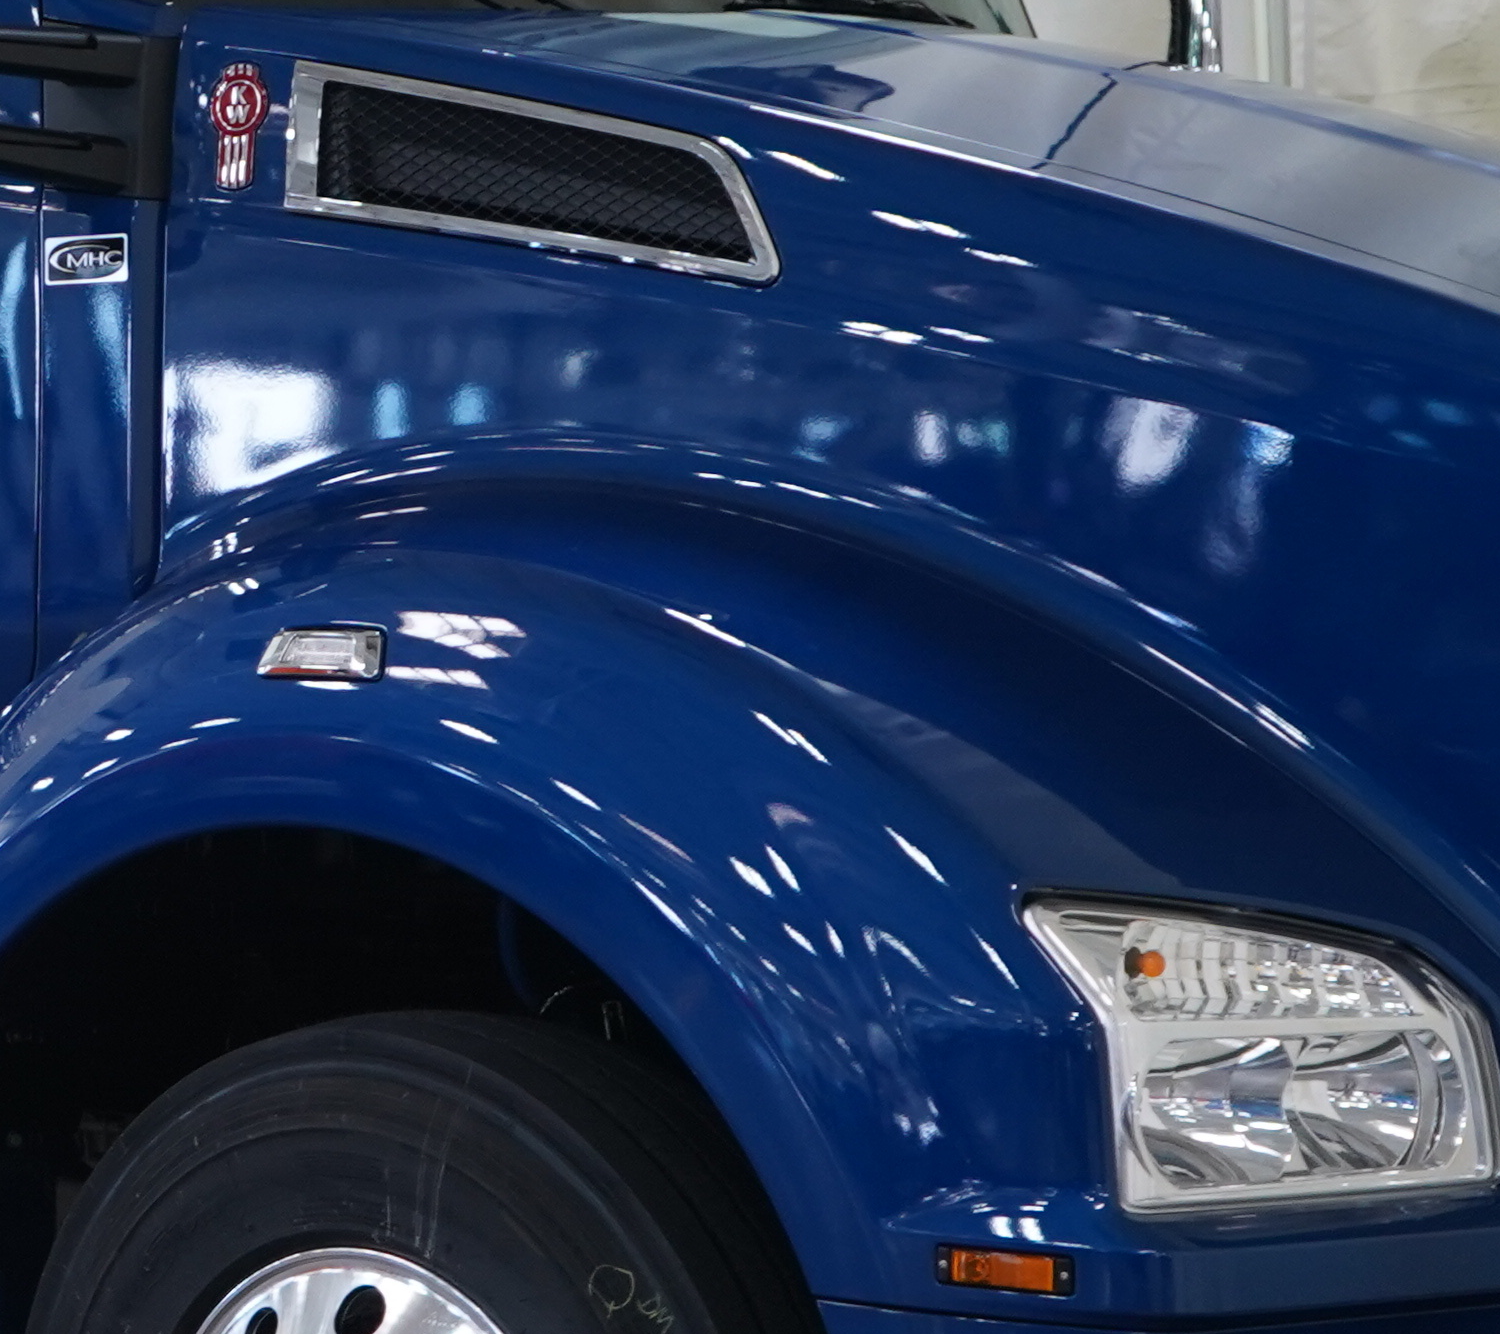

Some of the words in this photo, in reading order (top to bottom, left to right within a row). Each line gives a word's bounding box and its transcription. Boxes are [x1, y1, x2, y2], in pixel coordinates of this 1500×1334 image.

[230, 84, 248, 105] K
[226, 104, 250, 124] W
[66, 248, 124, 268] MHC
